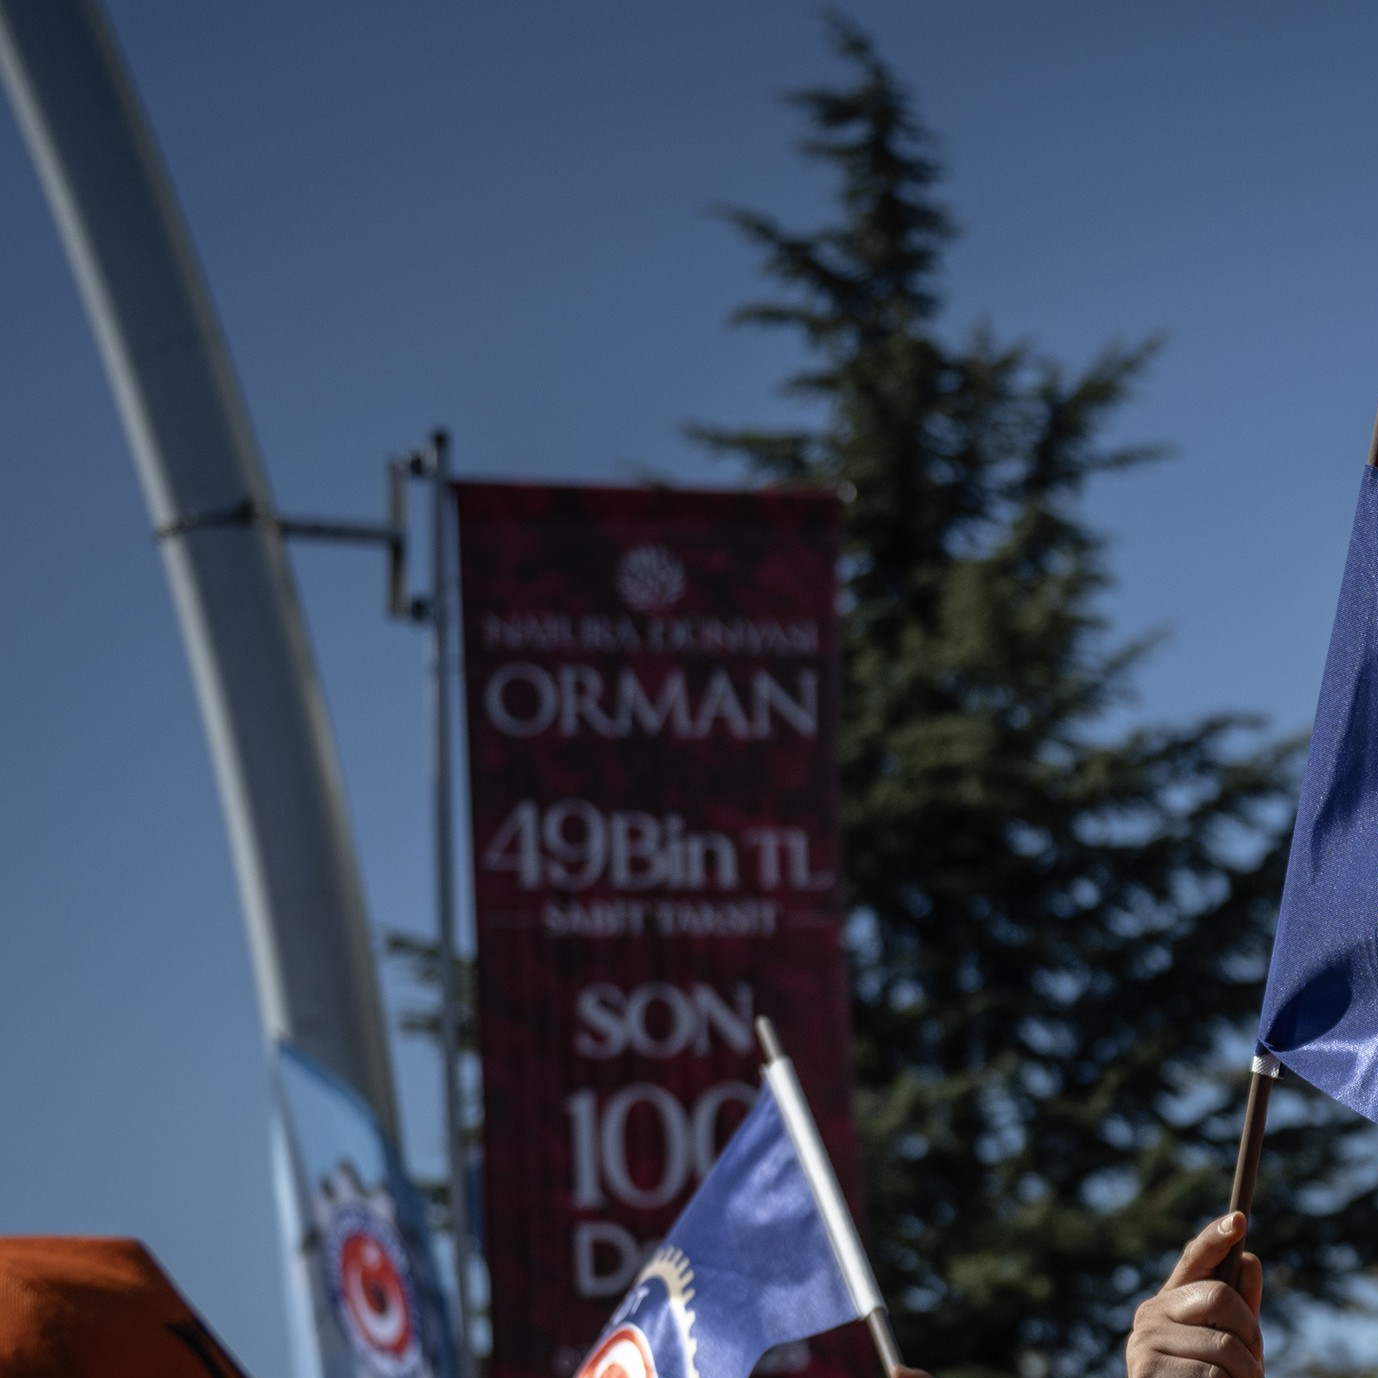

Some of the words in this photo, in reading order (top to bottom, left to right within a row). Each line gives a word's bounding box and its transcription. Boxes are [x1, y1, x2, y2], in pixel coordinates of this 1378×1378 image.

[484, 661, 818, 741] ORMAN
[742, 825, 837, 892] TL
[573, 979, 756, 1061] SON
